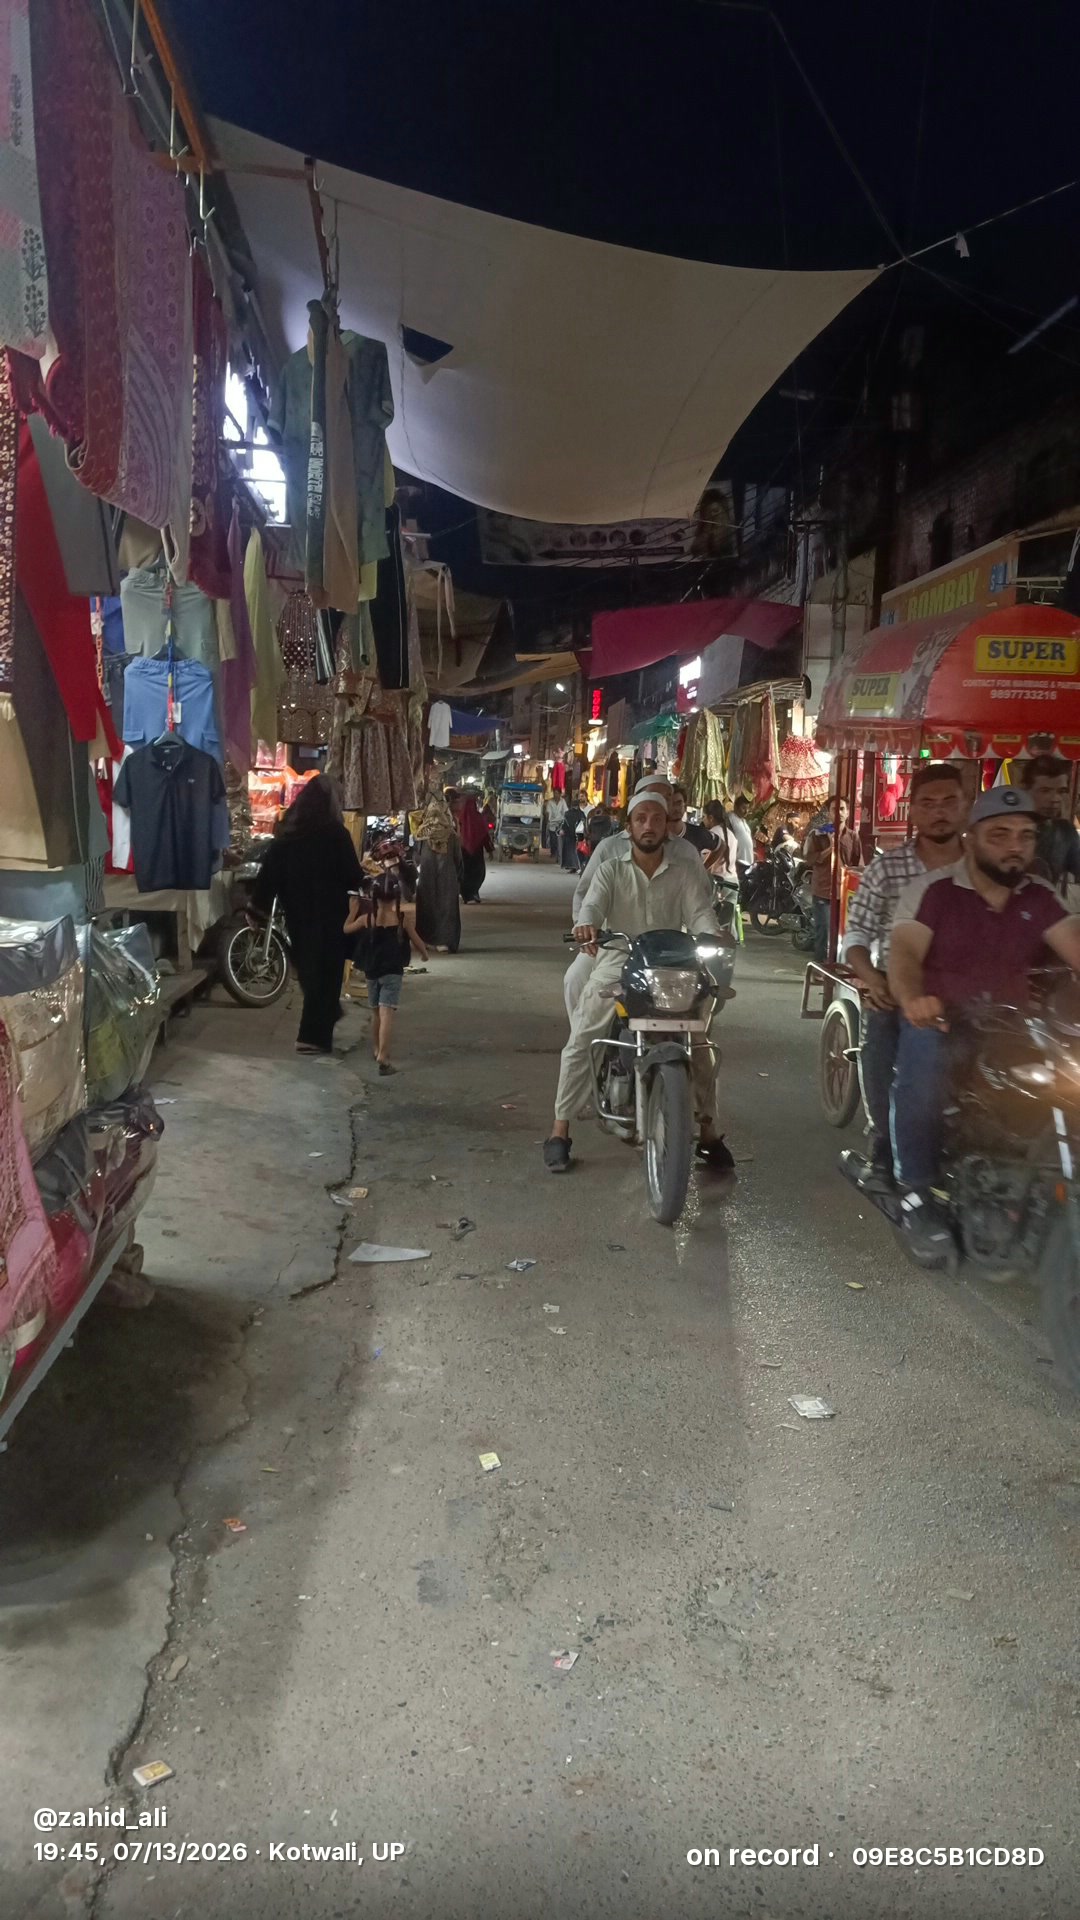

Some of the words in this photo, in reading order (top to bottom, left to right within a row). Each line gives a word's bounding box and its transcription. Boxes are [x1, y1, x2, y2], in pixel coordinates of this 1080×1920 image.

[308, 458, 323, 492] NORTH
[907, 567, 980, 622] BOMBAY
[988, 640, 1066, 661] SUPER
[851, 677, 891, 697] SUPER
